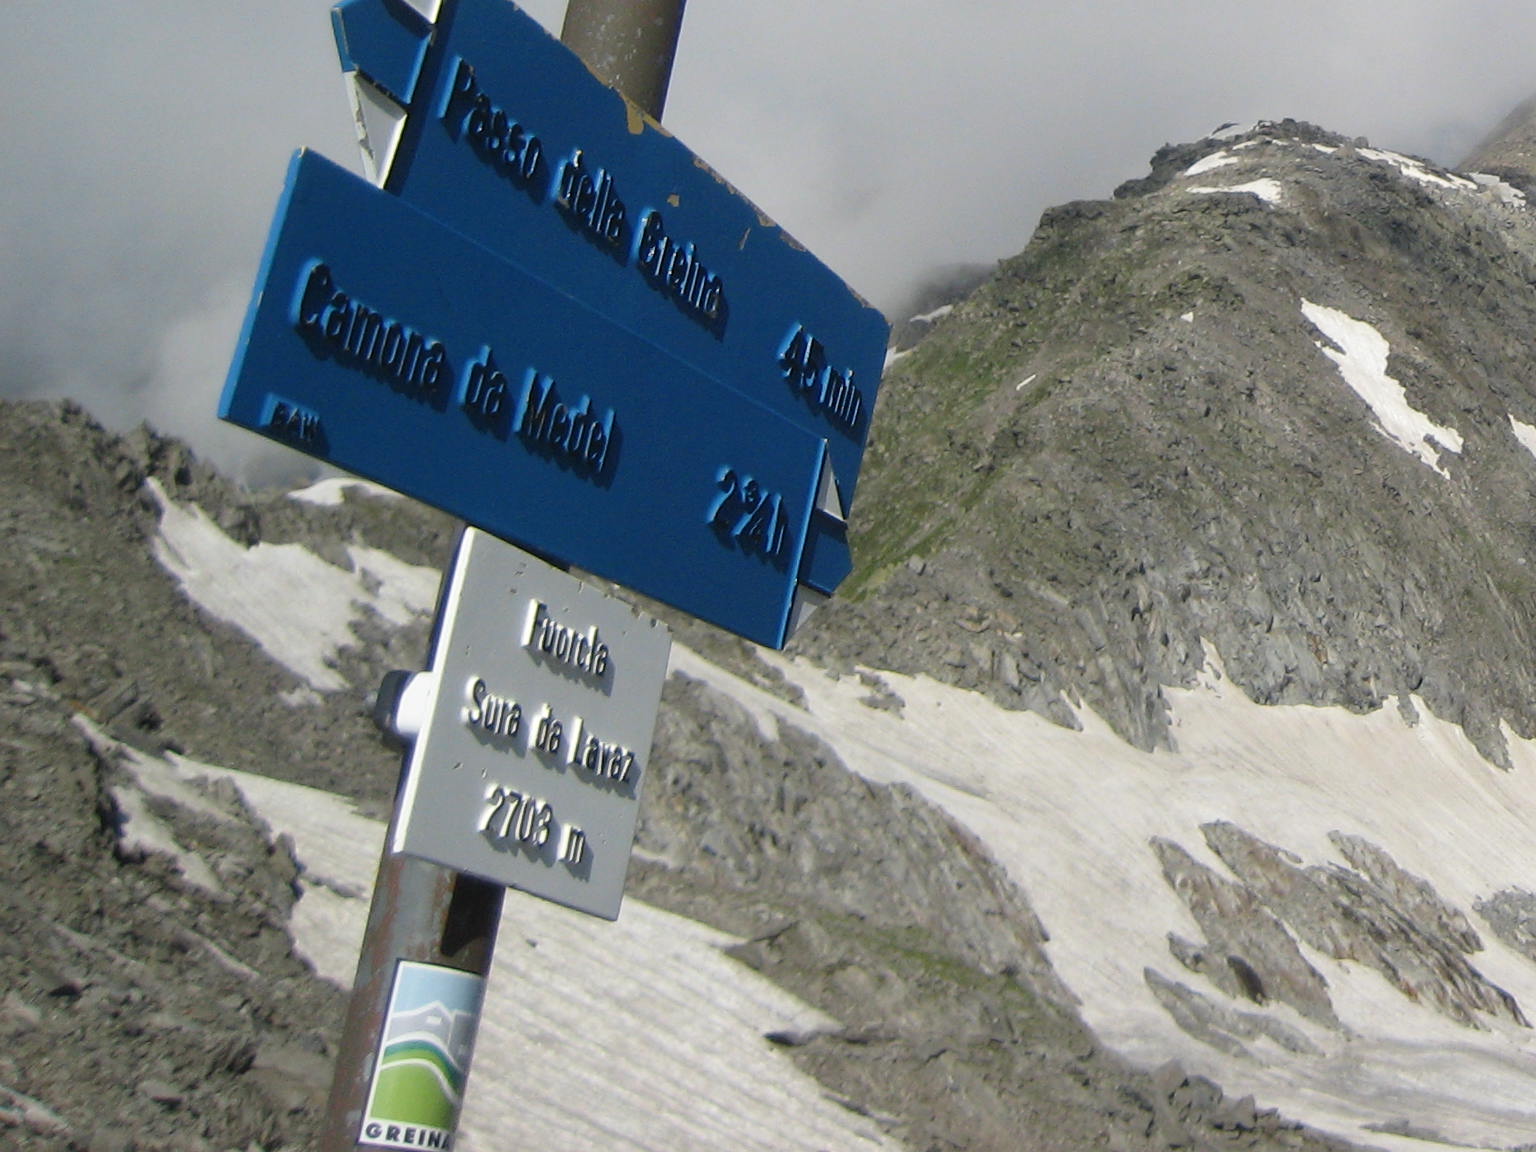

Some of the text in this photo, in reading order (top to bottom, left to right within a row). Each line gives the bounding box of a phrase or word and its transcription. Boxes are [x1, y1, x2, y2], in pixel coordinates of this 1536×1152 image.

[437, 55, 543, 182] Passo
[551, 148, 626, 246] della
[820, 364, 862, 427] min
[290, 257, 447, 388] Camona
[457, 344, 505, 416] da
[513, 366, 616, 473] Medel
[519, 598, 610, 675] Fuorcla
[461, 676, 636, 784] Sura da Lavaz
[556, 823, 587, 865] m
